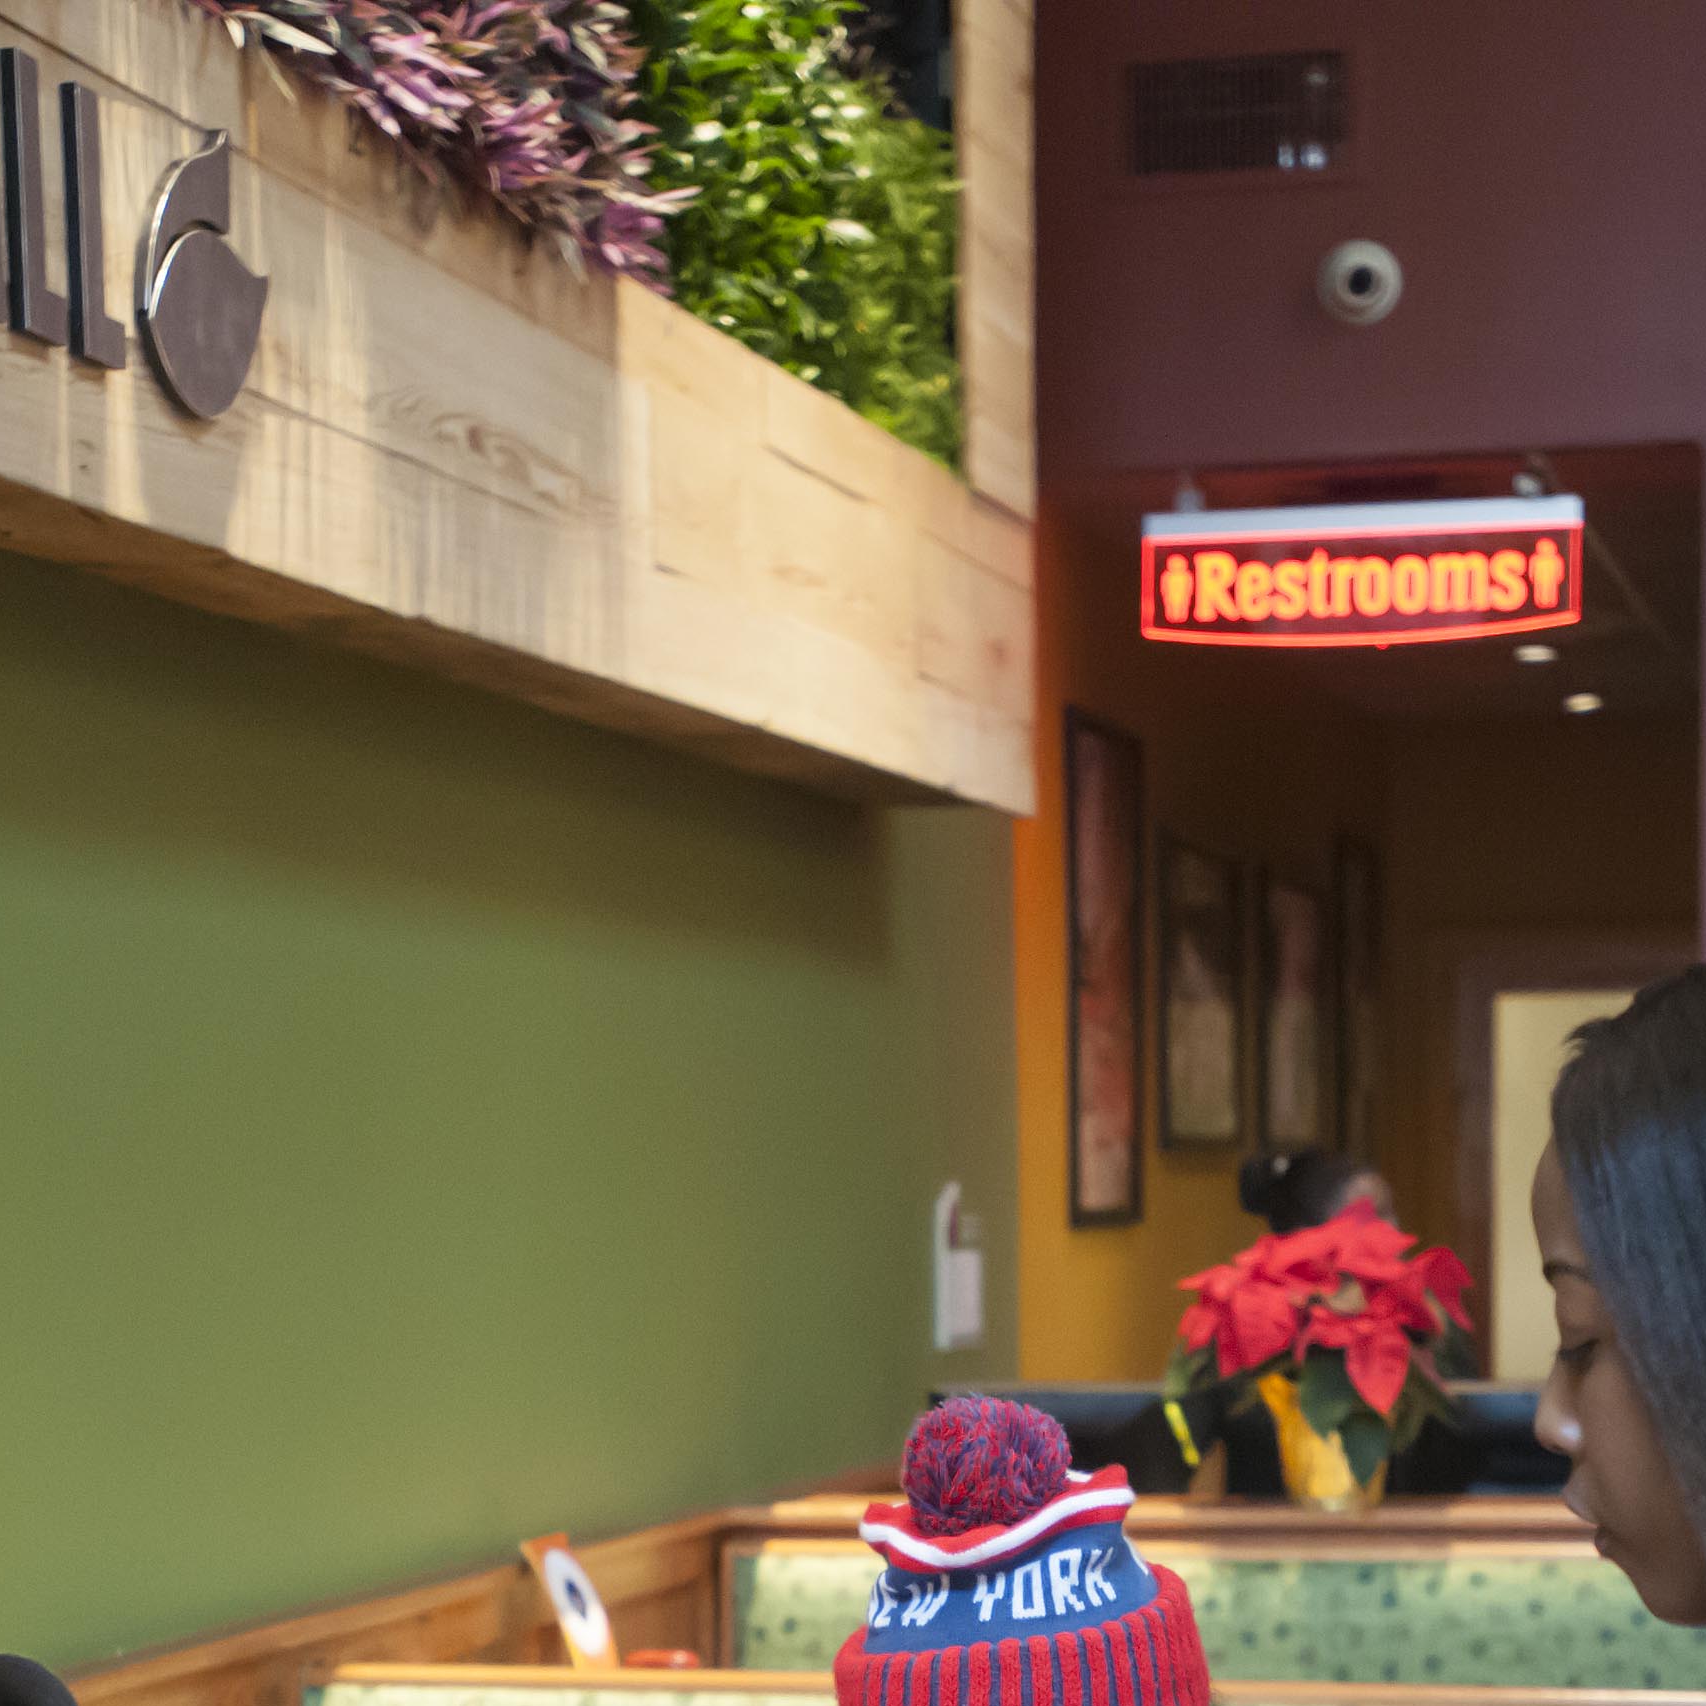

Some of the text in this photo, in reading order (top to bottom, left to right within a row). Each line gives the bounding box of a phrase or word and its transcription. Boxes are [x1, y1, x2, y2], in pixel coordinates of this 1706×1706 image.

[1193, 546, 1527, 623] Restrooms
[867, 1572, 950, 1629] NEW
[973, 1547, 1117, 1623] YORK
